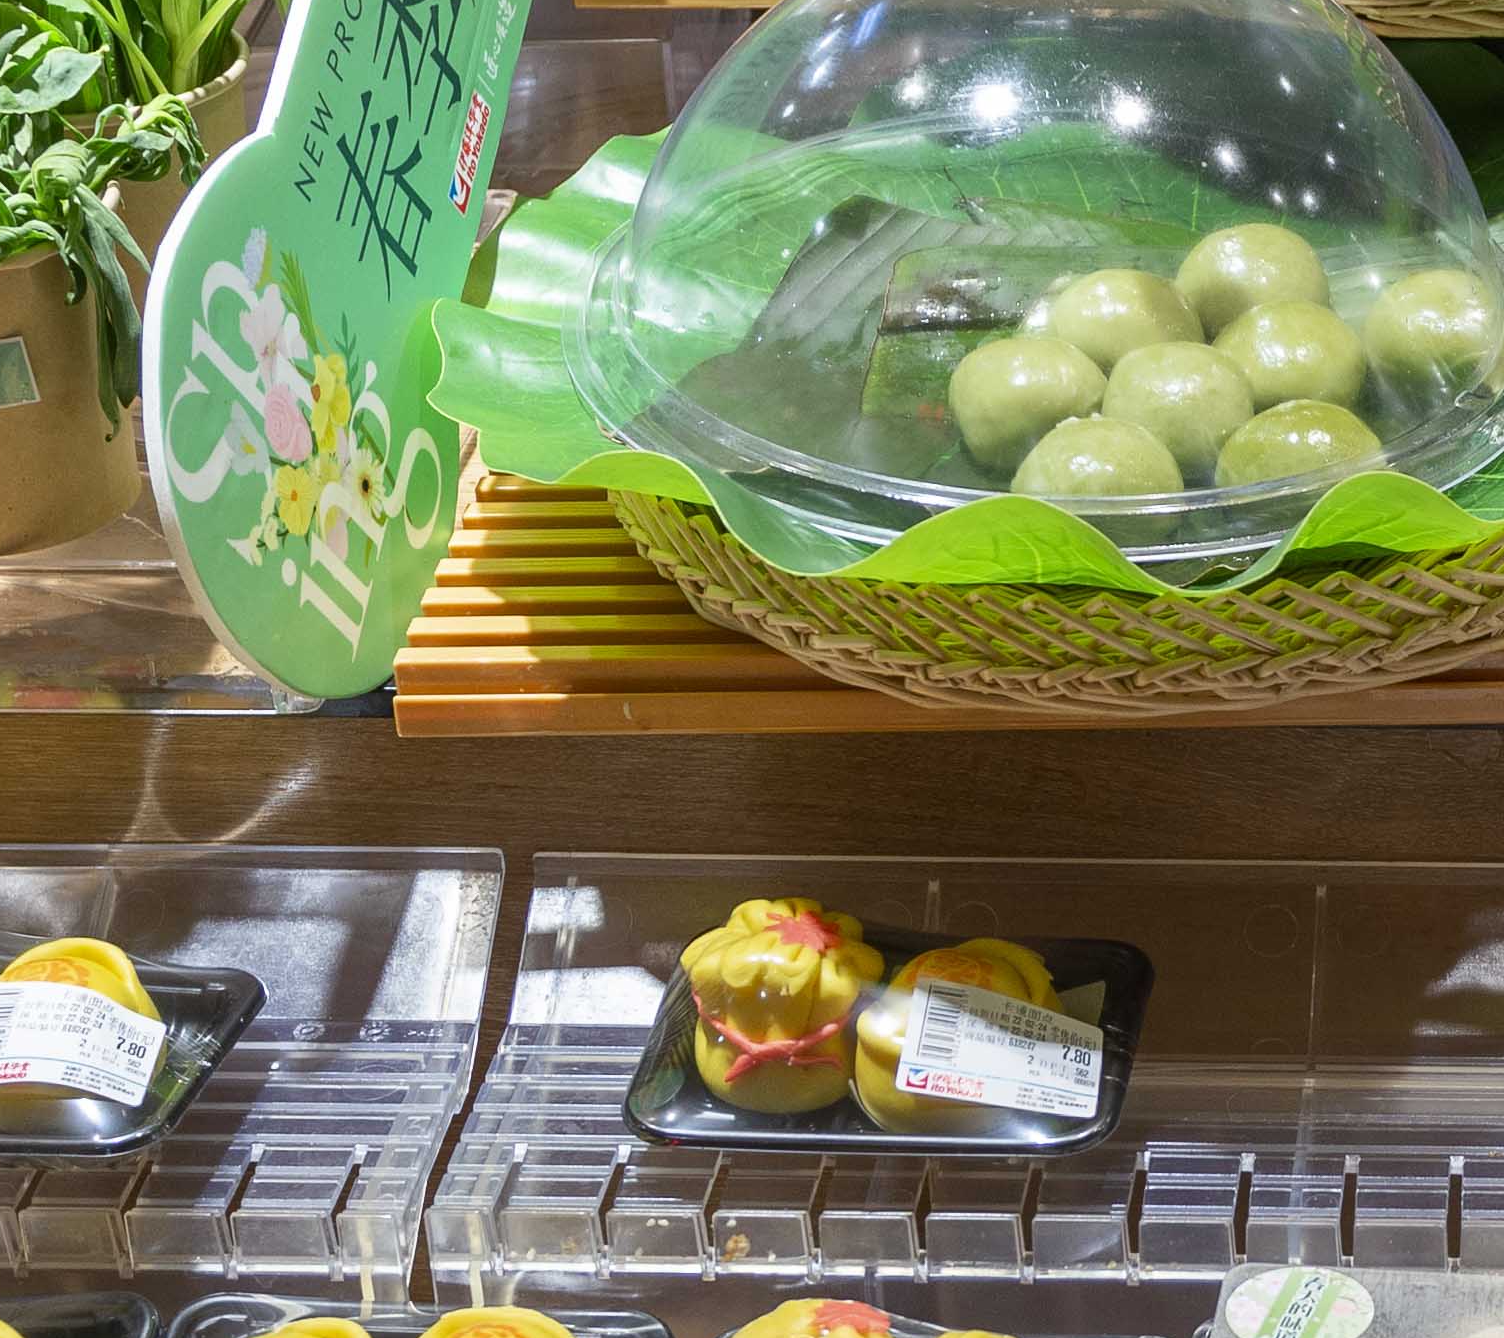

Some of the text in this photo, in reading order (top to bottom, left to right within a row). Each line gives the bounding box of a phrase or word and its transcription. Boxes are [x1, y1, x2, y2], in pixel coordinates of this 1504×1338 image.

[294, 100, 334, 203] NEW
[458, 92, 483, 172] 伊藤洋华堂
[471, 105, 491, 160] Yokado
[115, 1036, 148, 1059] 7.80
[1062, 1045, 1091, 1067] 7.80
